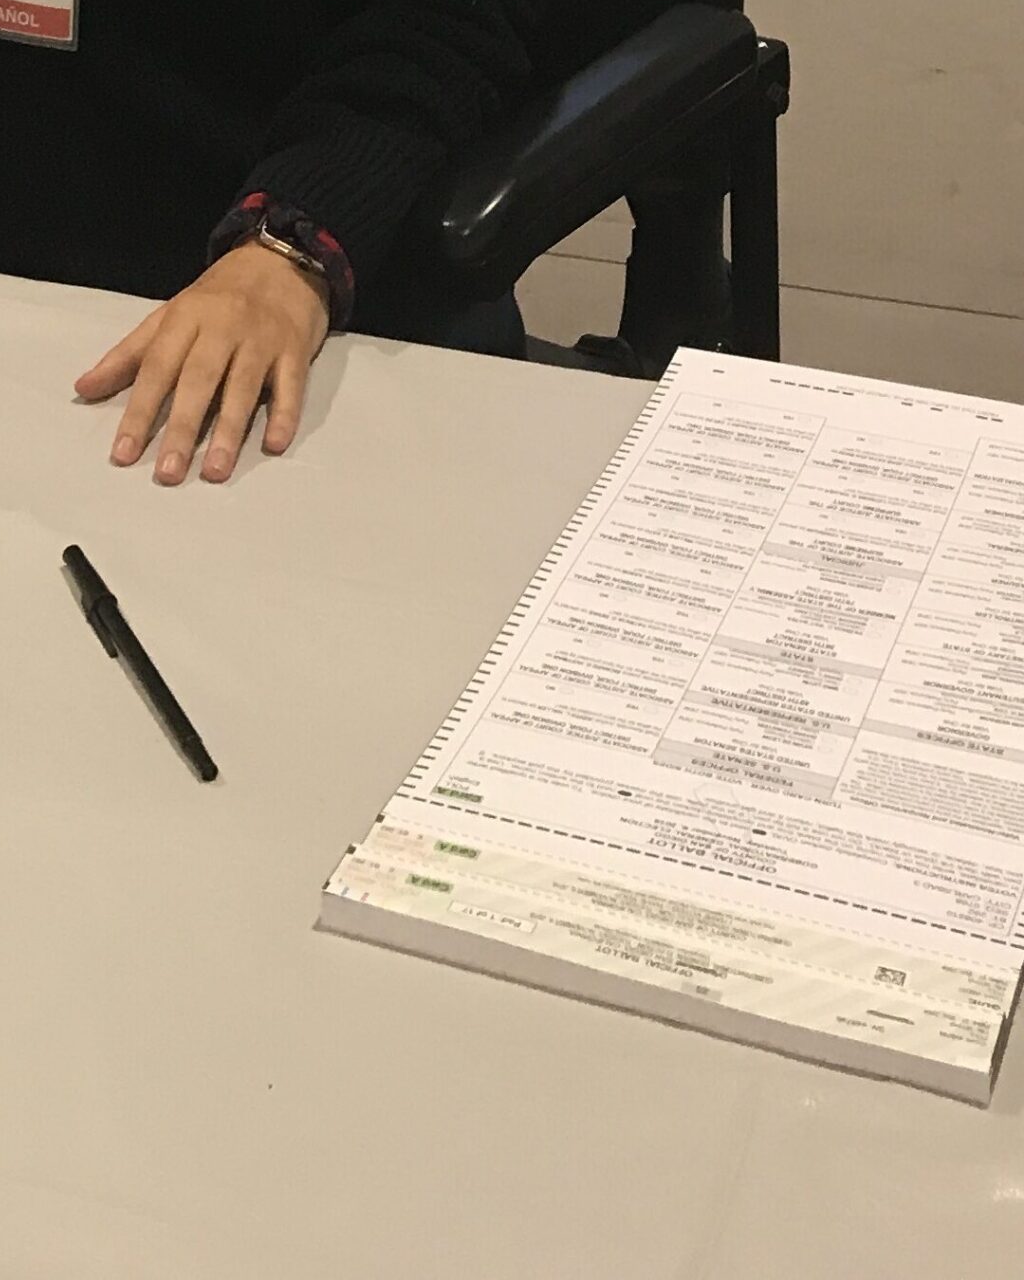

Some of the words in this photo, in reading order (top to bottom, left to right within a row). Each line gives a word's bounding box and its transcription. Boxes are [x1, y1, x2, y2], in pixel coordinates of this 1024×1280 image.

[436, 841, 450, 851] A
[645, 835, 707, 857] BALLOT
[709, 851, 778, 875] OFFICIAL
[407, 874, 422, 885] A
